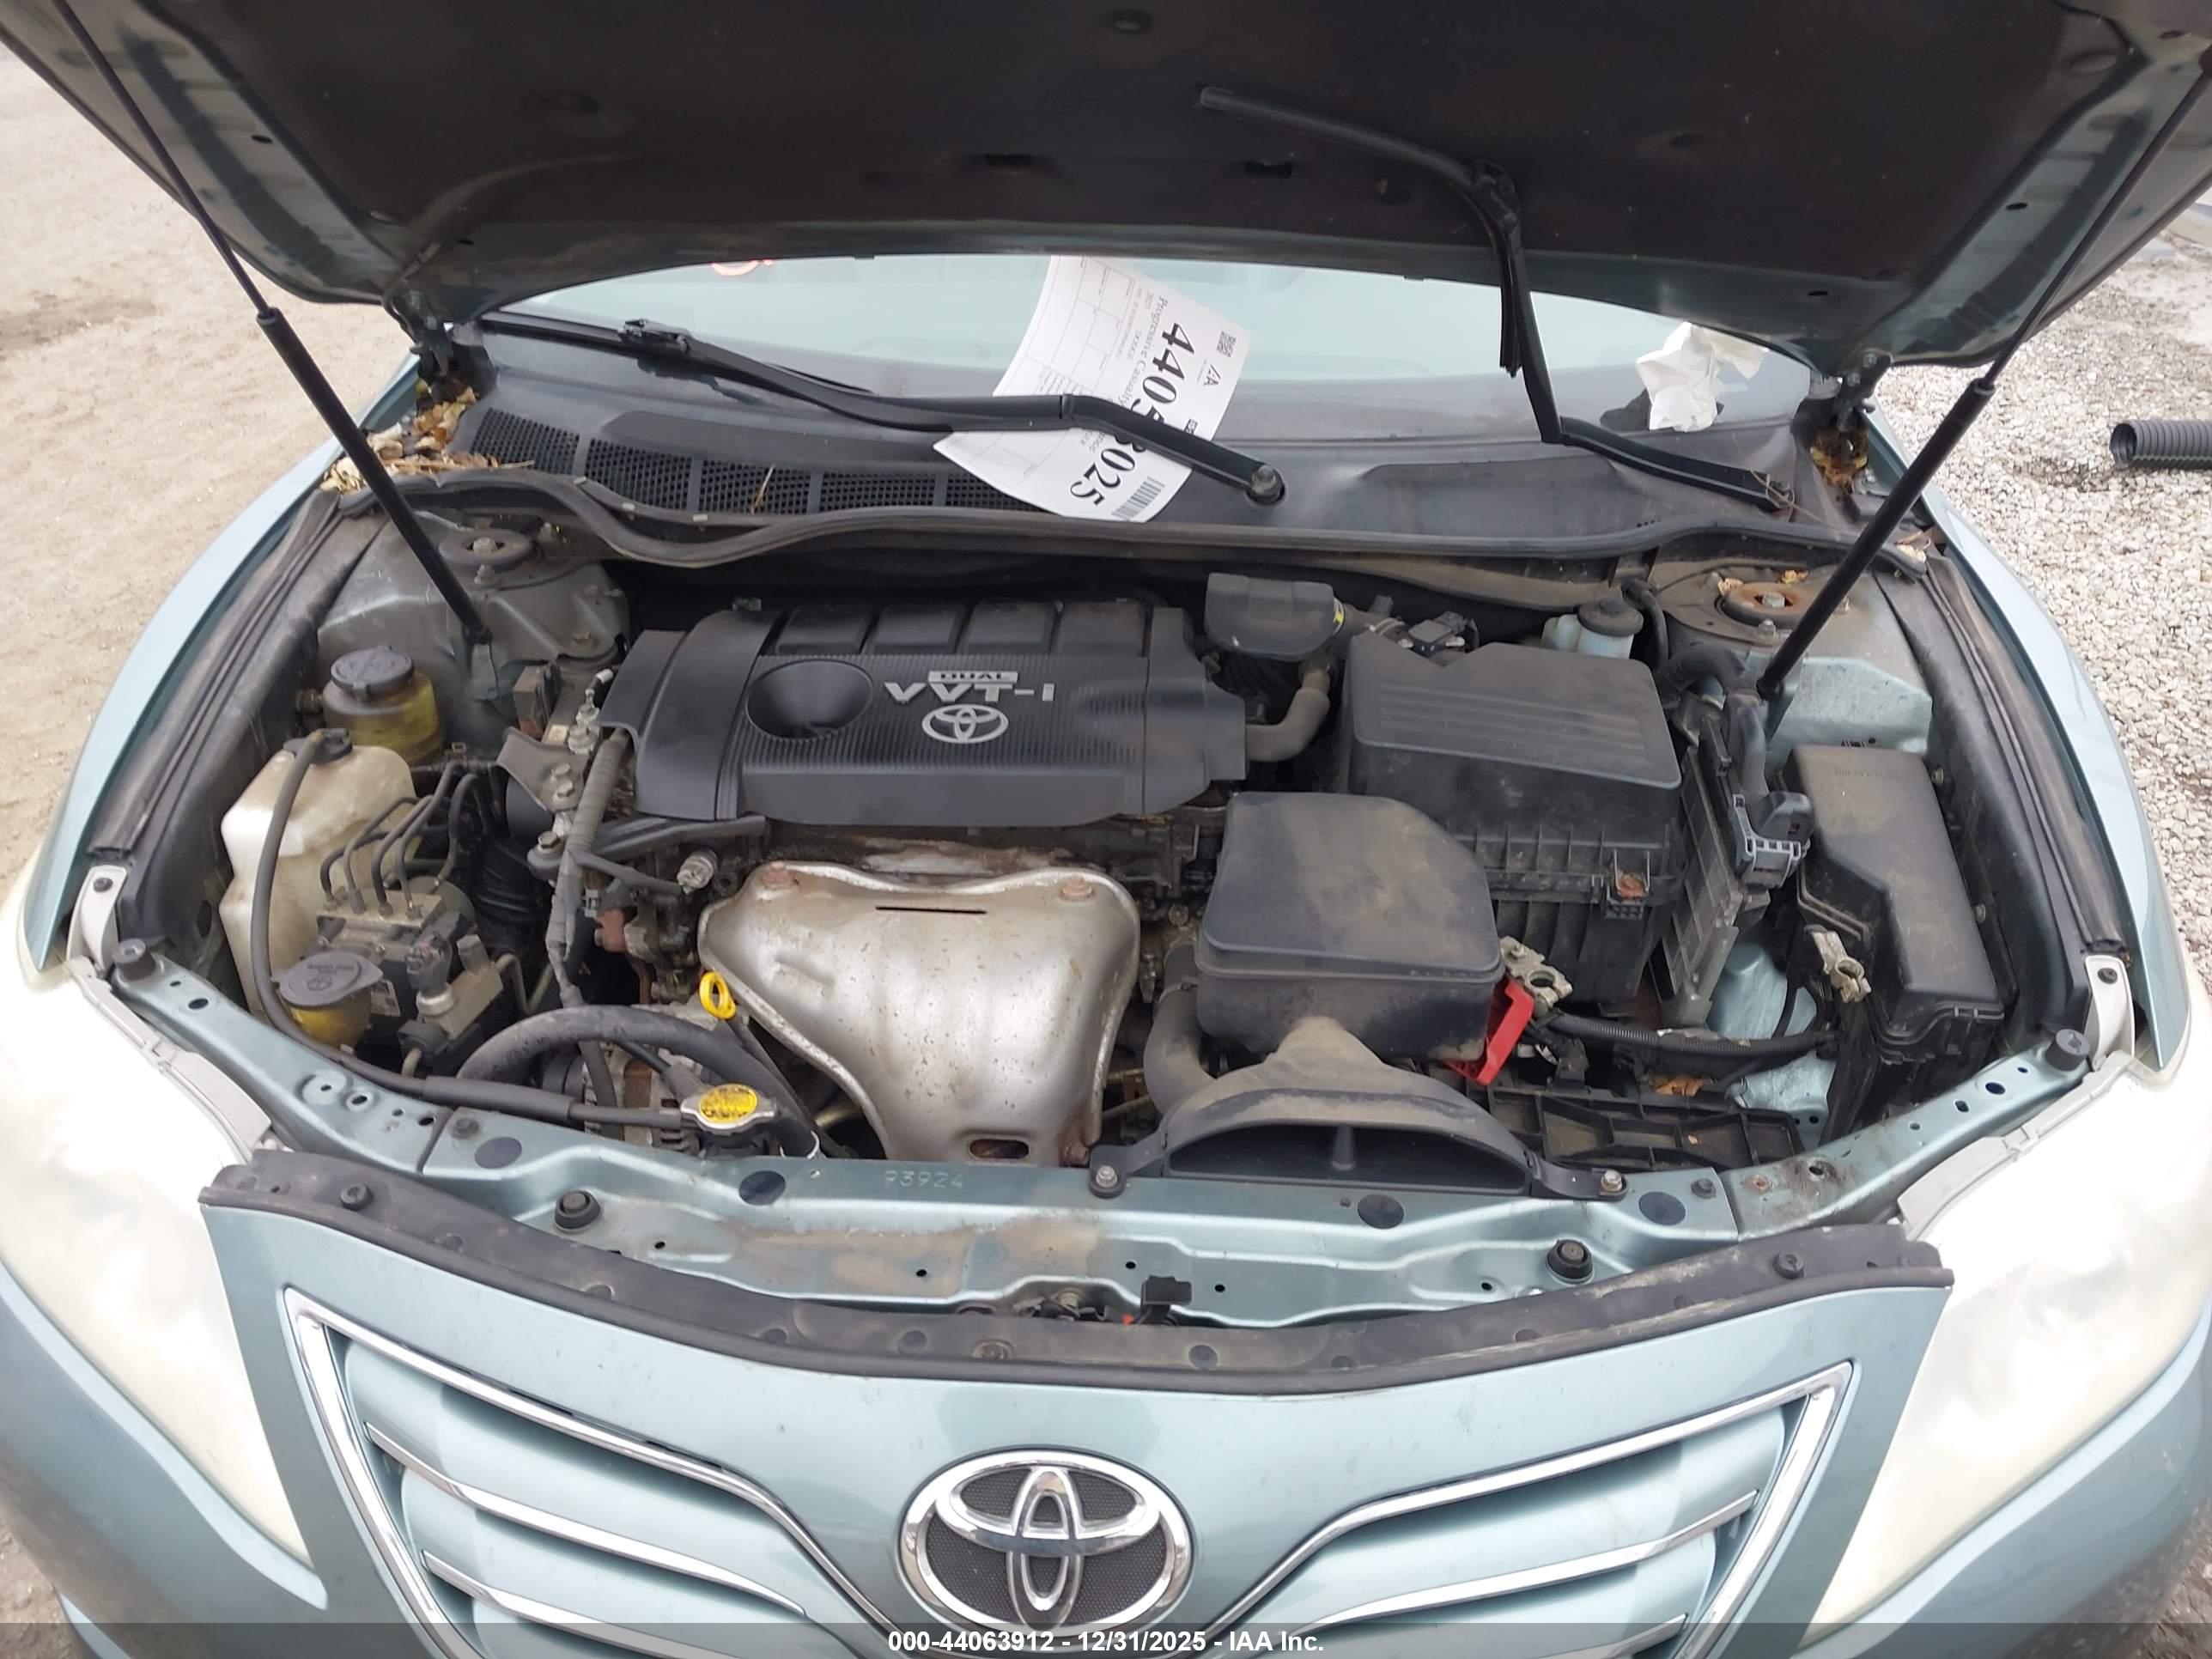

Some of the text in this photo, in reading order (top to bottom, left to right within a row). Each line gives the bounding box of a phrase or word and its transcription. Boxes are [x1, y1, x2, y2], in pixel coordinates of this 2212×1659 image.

[1140, 296, 1169, 359] Progressive
[1119, 359, 1147, 405] Casualty
[884, 1170, 963, 1188] 93924
